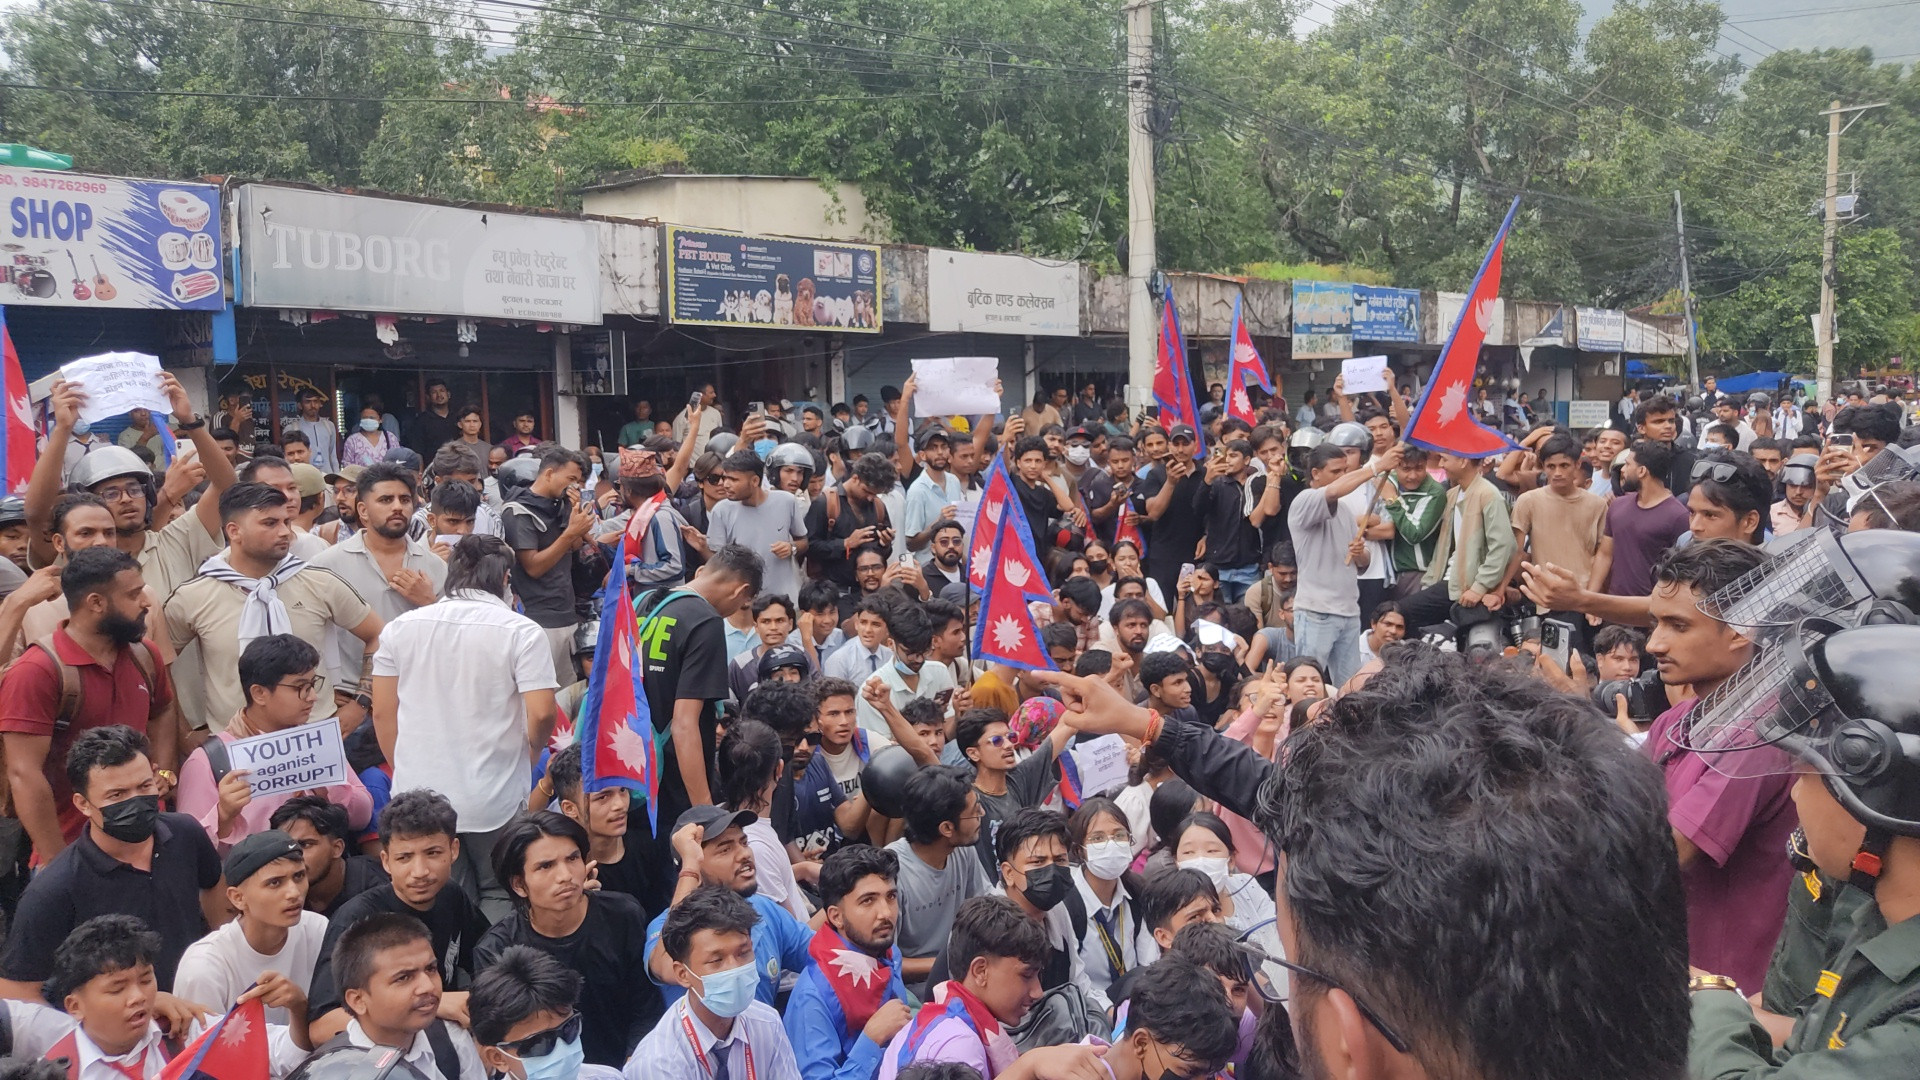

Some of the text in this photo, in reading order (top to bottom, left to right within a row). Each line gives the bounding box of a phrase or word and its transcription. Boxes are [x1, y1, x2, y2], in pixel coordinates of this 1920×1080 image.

[22, 176, 107, 194] 9847262969
[11, 196, 93, 242] SHOP
[267, 222, 455, 282] TUBORG
[678, 249, 732, 263] PET HOUSE
[996, 293, 1014, 307] एण्ड
[243, 729, 323, 764] YOUTH
[257, 752, 317, 777] aganist
